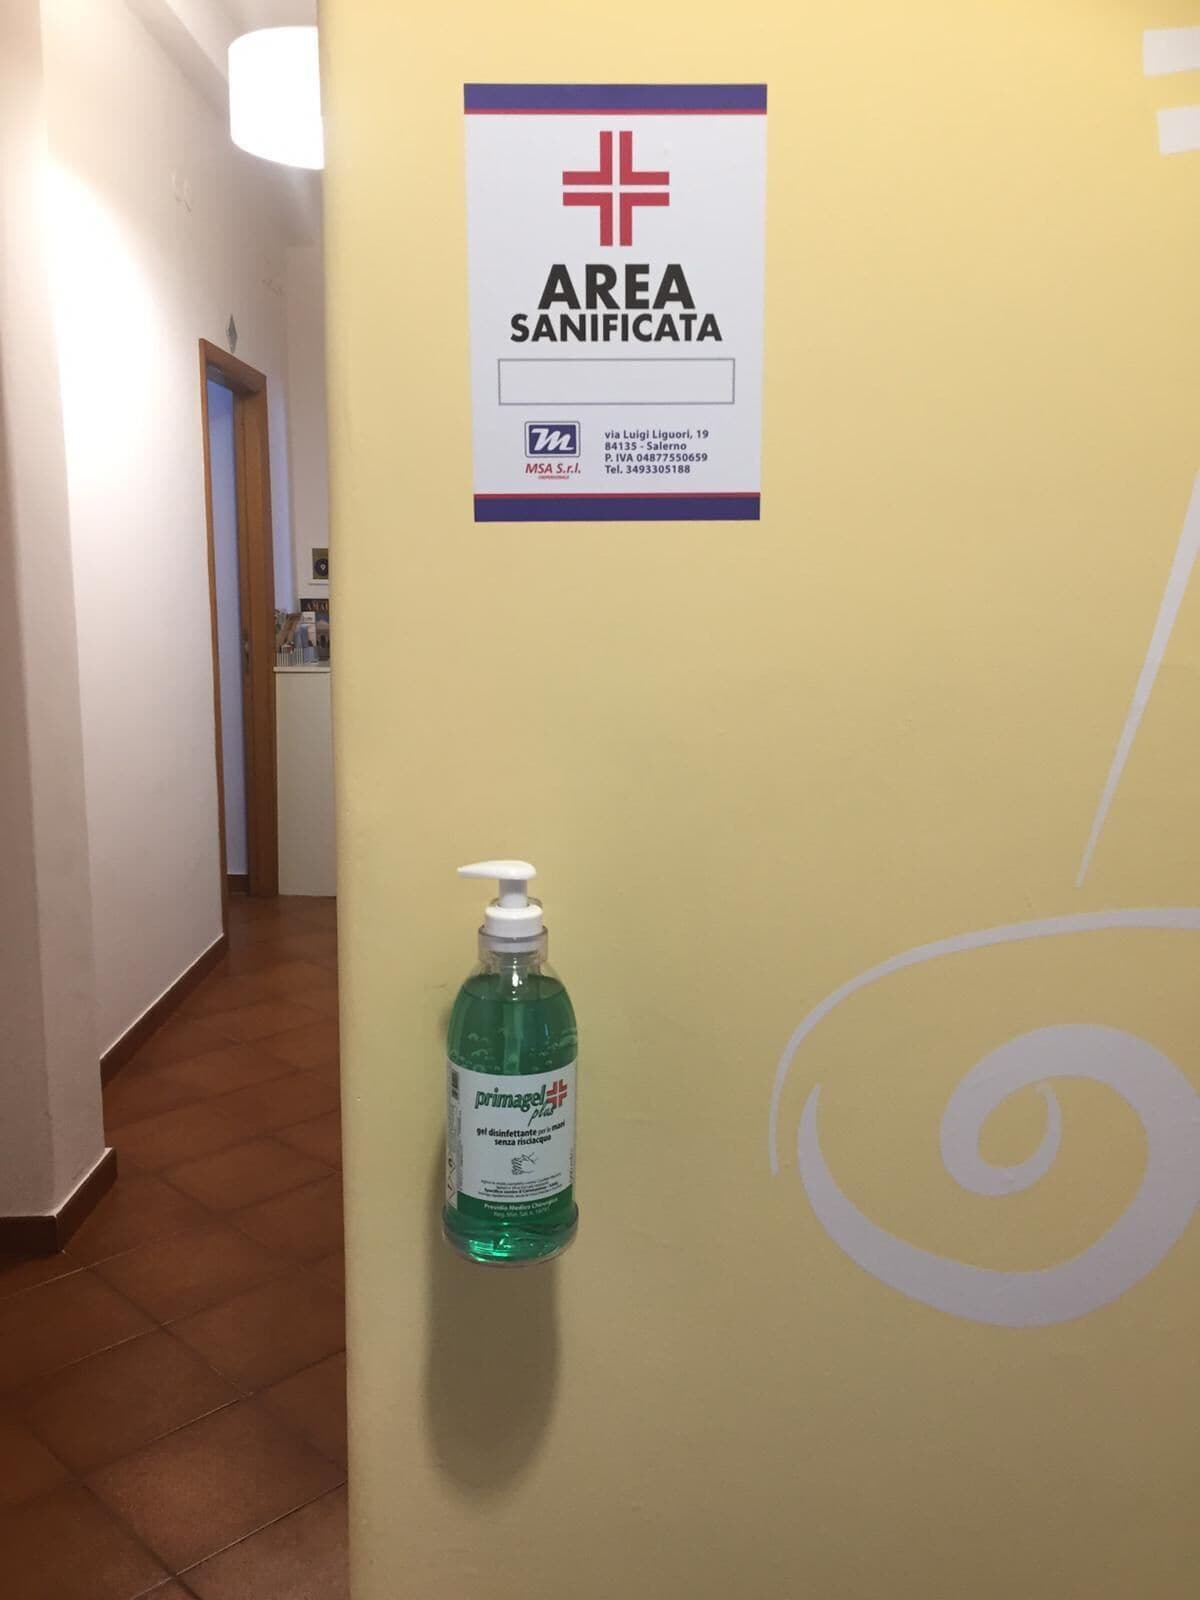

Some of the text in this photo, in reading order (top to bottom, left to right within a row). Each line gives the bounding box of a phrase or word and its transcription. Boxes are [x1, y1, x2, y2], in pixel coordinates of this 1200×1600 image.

[537, 263, 696, 310] AREA
[510, 313, 723, 343] SANIFICATA
[604, 429, 709, 441] via Luigi Liguori, 19
[604, 441, 638, 451] 84135
[646, 441, 687, 451] Salerno
[604, 453, 708, 462] P. IVA 04877550659
[525, 462, 581, 474] MSA S.r.l.
[604, 464, 691, 474] Tel. 3493305188
[474, 1084, 546, 1112] primagel
[527, 1101, 557, 1127] plus
[476, 1127, 488, 1137] gel
[488, 1128, 537, 1138] disinfettante
[494, 1138, 516, 1146] senza
